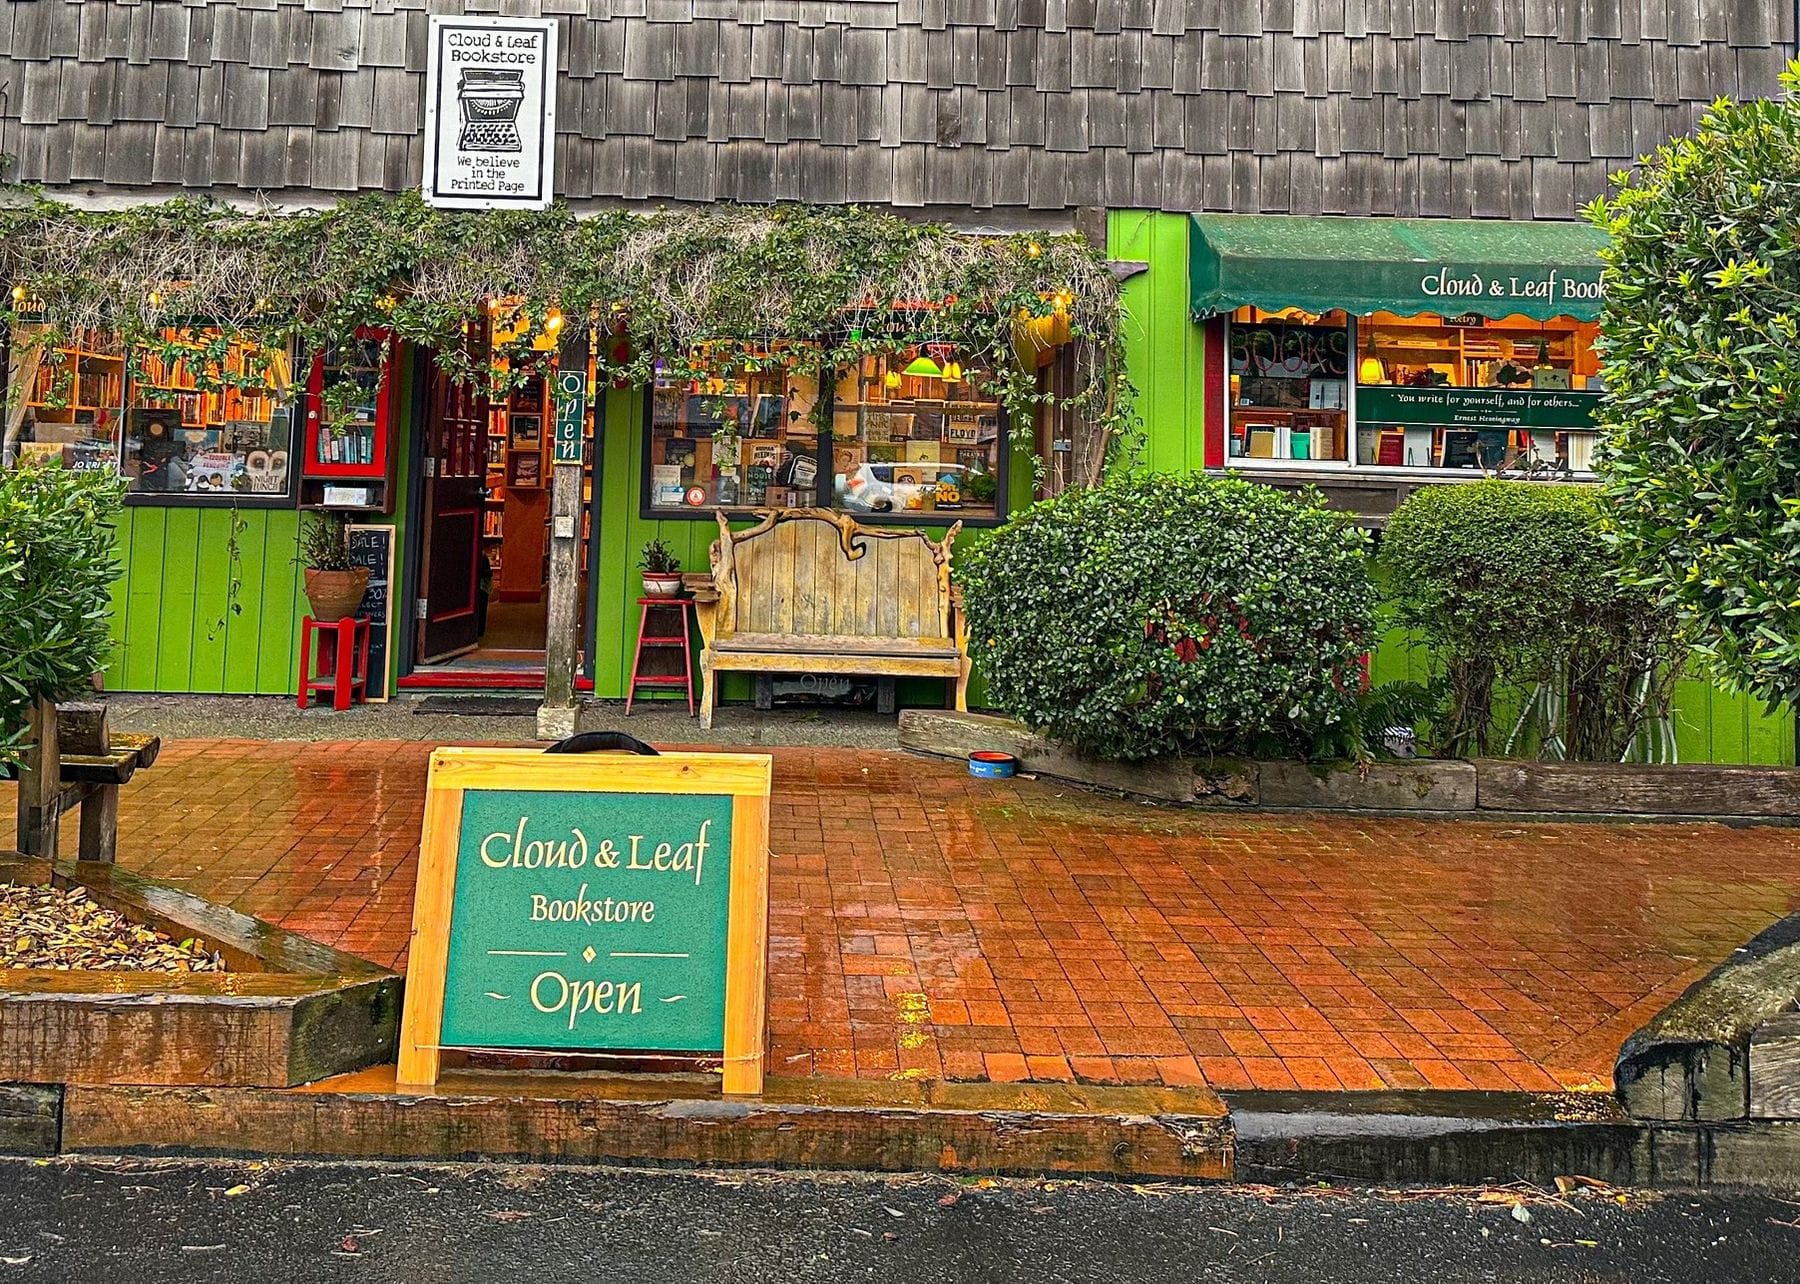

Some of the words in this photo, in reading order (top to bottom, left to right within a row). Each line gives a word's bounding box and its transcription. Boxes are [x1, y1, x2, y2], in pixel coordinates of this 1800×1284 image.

[448, 33, 491, 48] Cloud
[495, 35, 504, 48] &
[508, 35, 539, 49] Leaf
[451, 49, 536, 64] Bookstore
[457, 156, 472, 167] We
[475, 155, 520, 168] believe
[471, 166, 483, 179] in
[487, 168, 506, 179] the
[451, 178, 495, 191] Printed
[498, 181, 525, 193] Page
[1421, 267, 1483, 296] Cloud
[1489, 281, 1505, 296] &
[1509, 269, 1557, 305] Leaf
[1231, 328, 1347, 374] BOOKS
[1418, 395, 1443, 404] write
[1446, 393, 1460, 406] for
[1463, 394, 1505, 408] yourself,
[1507, 396, 1525, 406] and
[1528, 395, 1542, 408] for
[562, 375, 581, 459] Open
[480, 816, 589, 869] Cloud
[594, 839, 621, 869] &
[625, 819, 711, 886] Leaf
[529, 883, 655, 926] Bookstore
[530, 971, 643, 1030] Open
